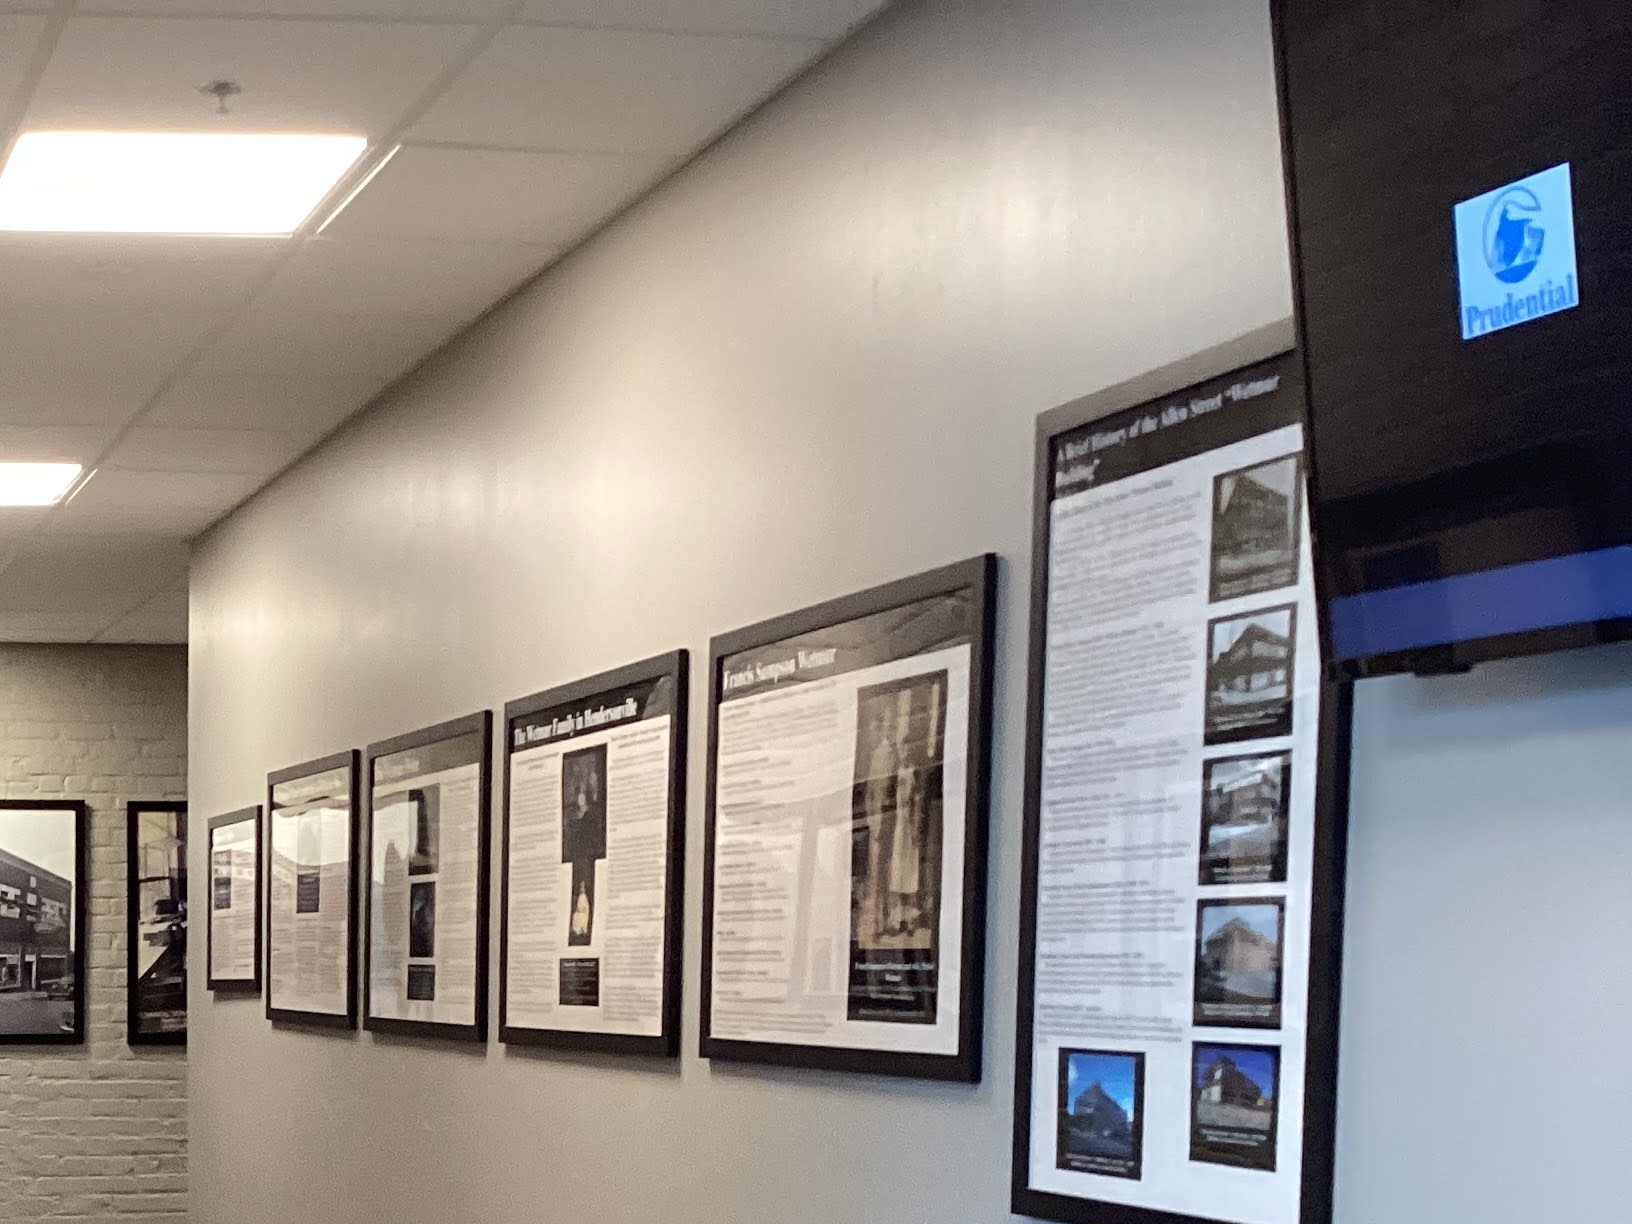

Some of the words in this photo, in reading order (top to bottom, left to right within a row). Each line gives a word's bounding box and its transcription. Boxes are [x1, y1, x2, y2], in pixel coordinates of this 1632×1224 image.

[1466, 273, 1574, 336] Prudential
[1090, 427, 1128, 451] History
[1128, 418, 1142, 439] of
[1141, 415, 1158, 435] the
[1189, 392, 1223, 416] Street
[723, 663, 755, 691] Francis
[514, 728, 526, 746] The
[552, 717, 575, 738] Family
[575, 711, 584, 731] in
